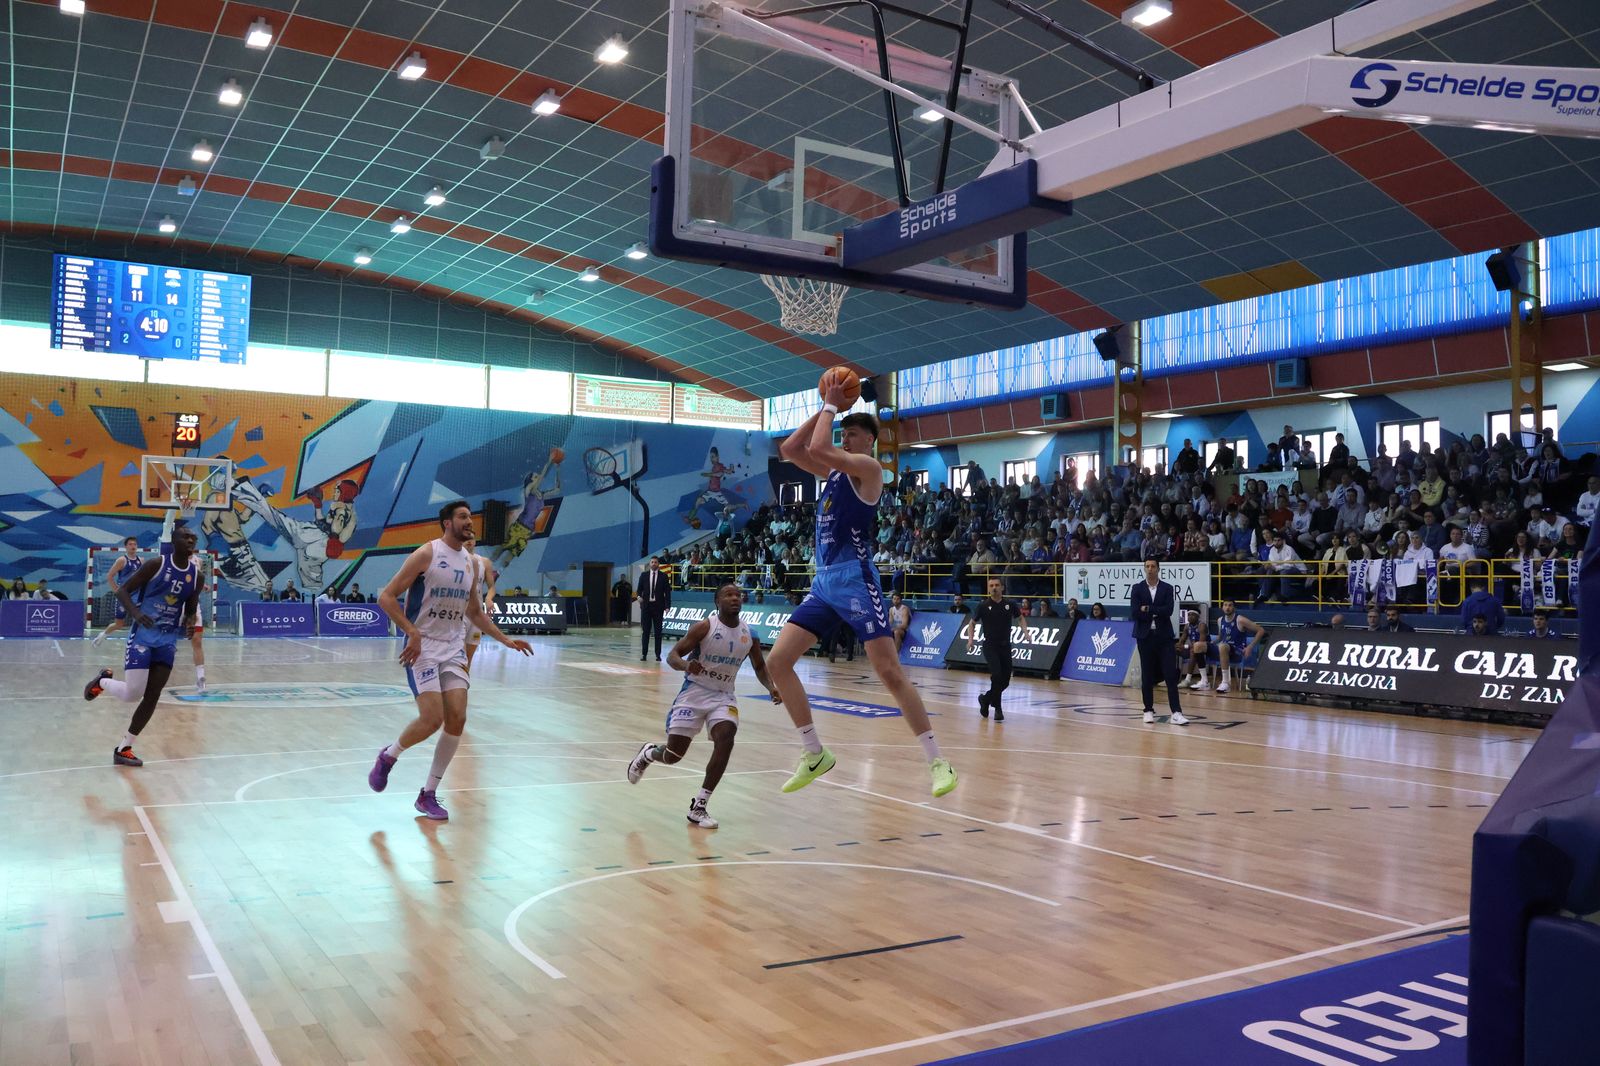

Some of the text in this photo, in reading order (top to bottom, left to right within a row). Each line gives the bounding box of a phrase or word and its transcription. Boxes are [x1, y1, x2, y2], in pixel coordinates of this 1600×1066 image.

[1404, 71, 1526, 99] Schelde
[1531, 78, 1600, 108] Spo
[1556, 104, 1596, 116] Superior
[900, 192, 957, 223] Schelde
[900, 208, 957, 239] Sports
[131, 290, 143, 302] 11
[166, 293, 178, 306] 14
[140, 316, 169, 334] 4:10
[123, 333, 129, 344] 2
[176, 427, 197, 441] 20
[454, 569, 465, 584] 77
[1098, 568, 1195, 580] AYUNTAENTO
[171, 579, 184, 594] 15
[1098, 584, 1195, 600] DE ZRA
[430, 587, 471, 600] MENORC
[31, 608, 55, 619] AC
[505, 602, 563, 615] RURAL
[676, 608, 706, 621] RURAL
[252, 616, 305, 624] DISCOLO
[333, 611, 373, 621] FERRERO
[498, 616, 546, 625] ZAMORA
[729, 641, 734, 653] 1
[909, 646, 922, 654] CAJA
[1076, 655, 1116, 668] CAJA RURAL
[1267, 640, 1331, 666] CAJA
[1337, 643, 1440, 672] RURAL
[1454, 650, 1538, 679] CAJA
[1086, 665, 1107, 673] ZAMORA
[1284, 668, 1309, 683] DE
[1315, 669, 1397, 691] ZAMORA
[1479, 683, 1515, 700] DE
